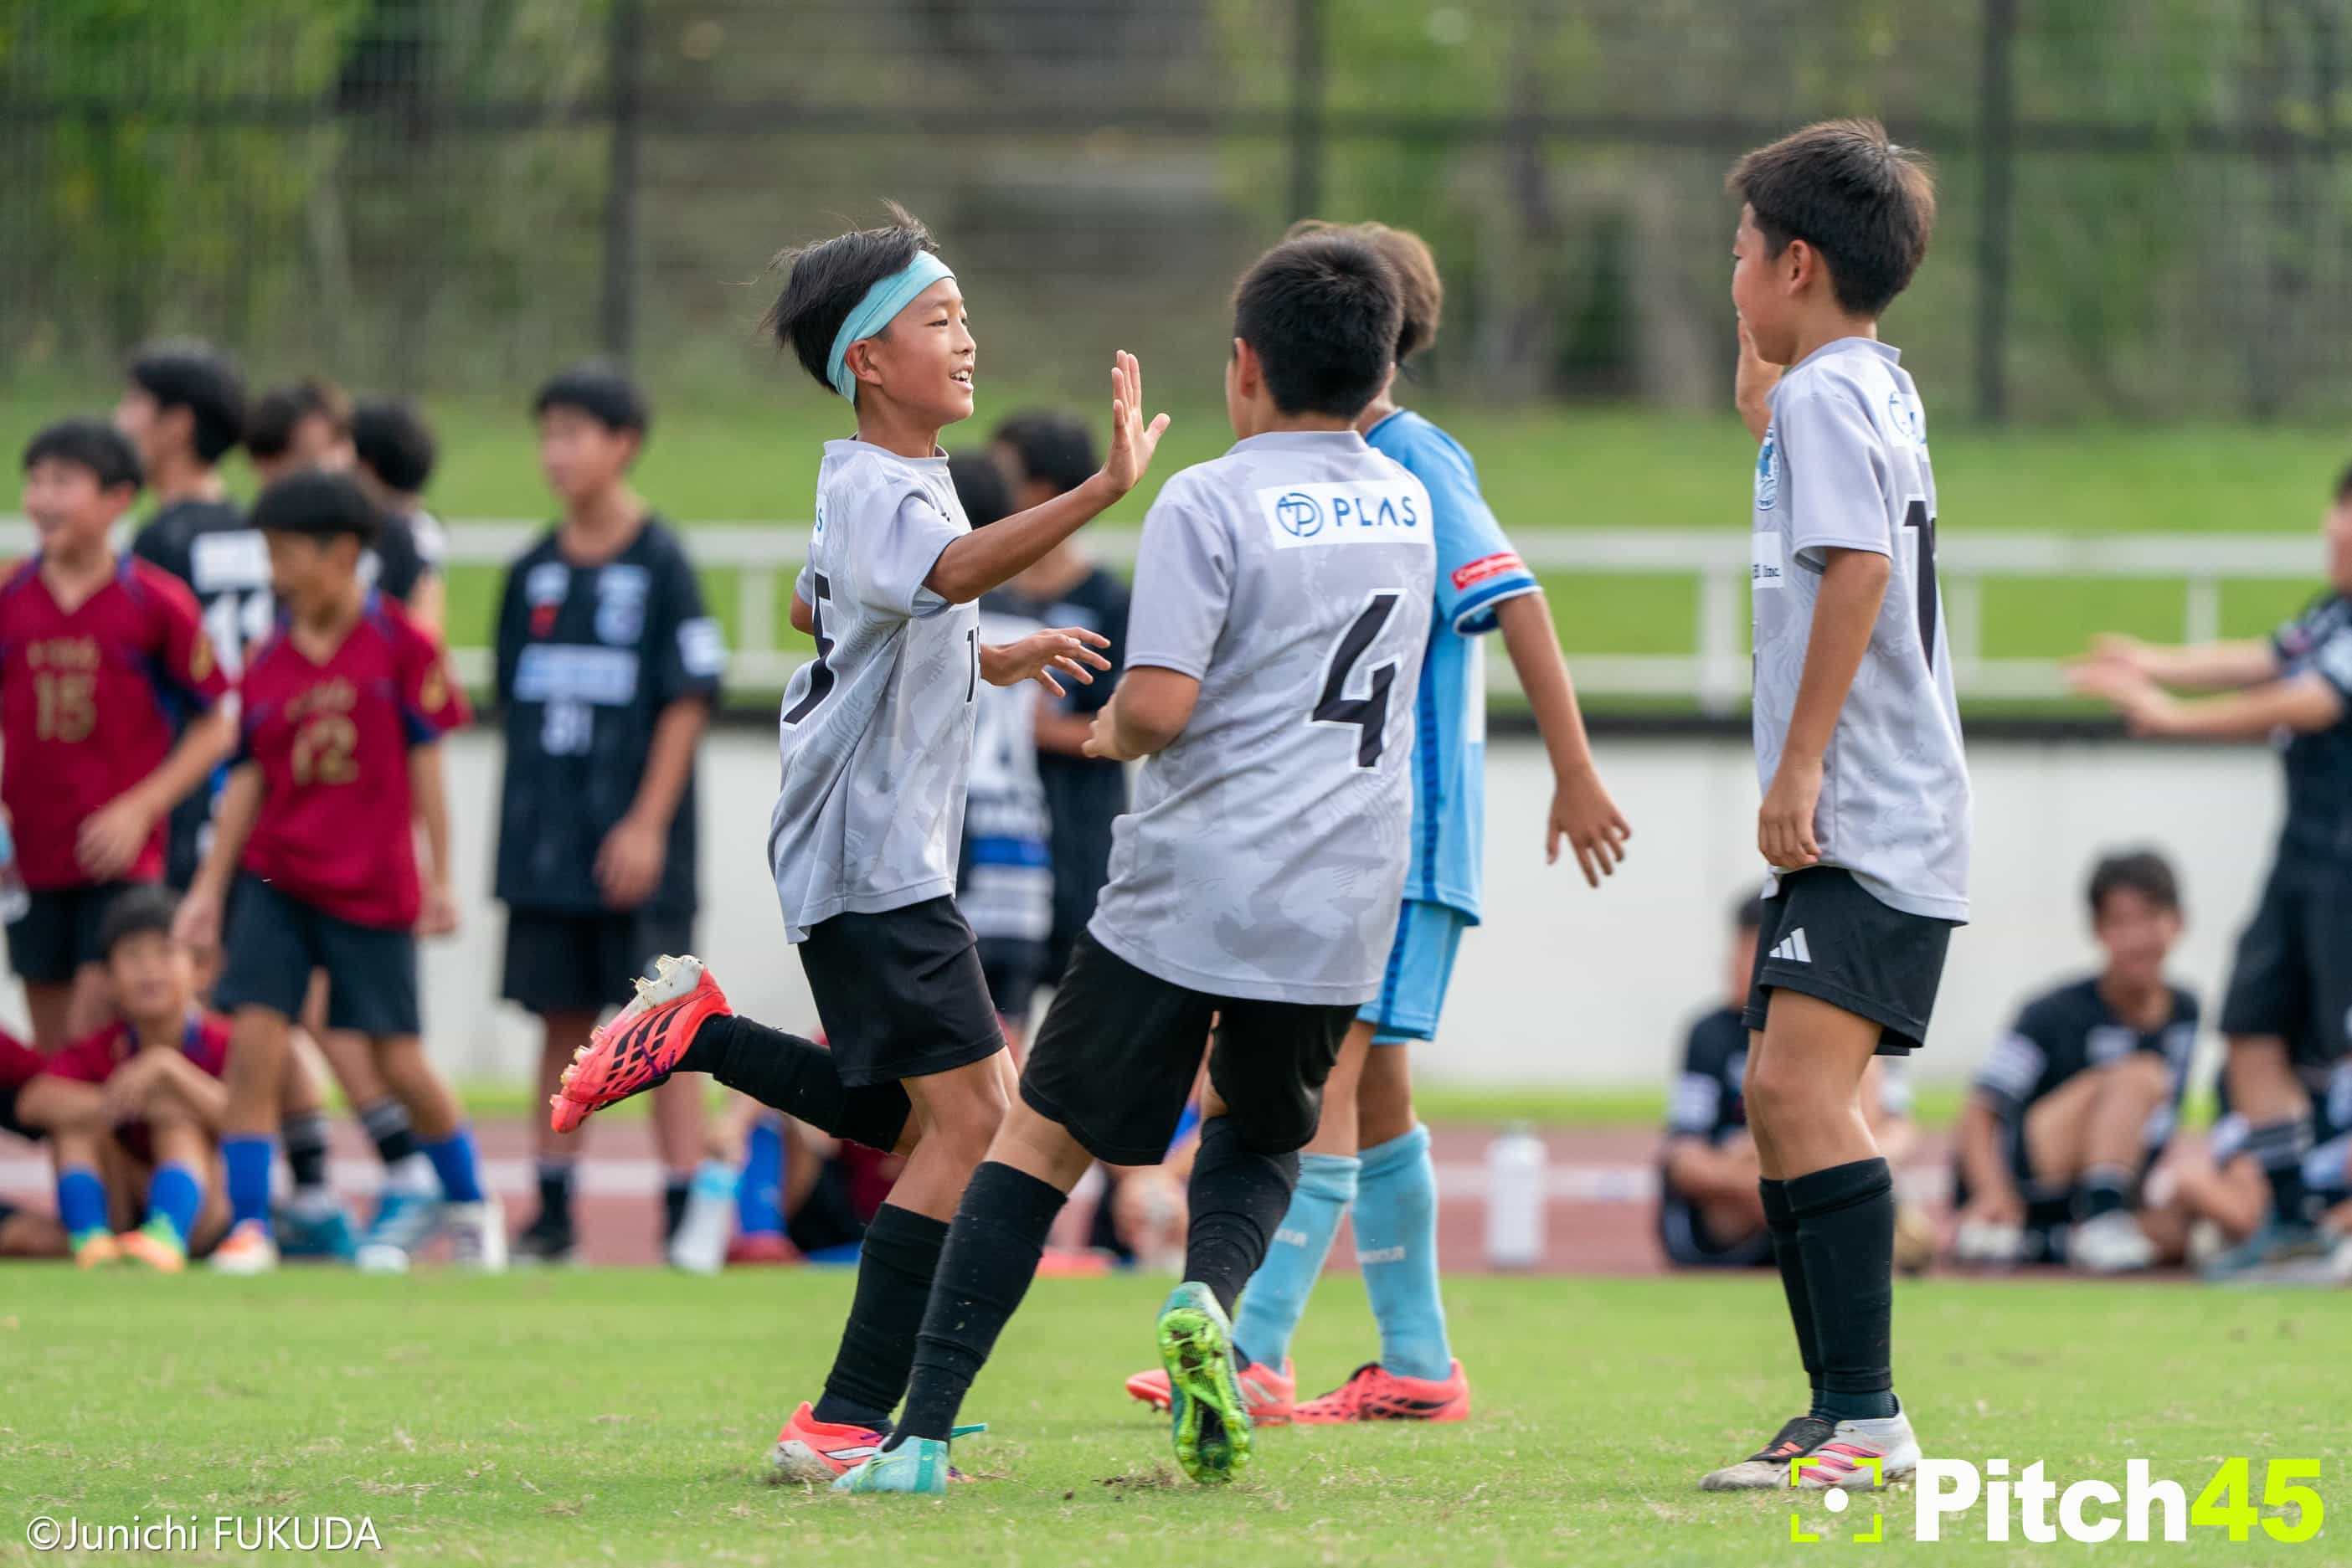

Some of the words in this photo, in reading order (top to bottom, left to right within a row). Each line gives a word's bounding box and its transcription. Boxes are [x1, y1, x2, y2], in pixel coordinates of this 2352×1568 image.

[1332, 496, 1417, 527] PLAS
[1904, 500, 1937, 676] 1
[965, 625, 980, 703] 1
[1308, 591, 1403, 770] 4
[292, 716, 359, 786] 12
